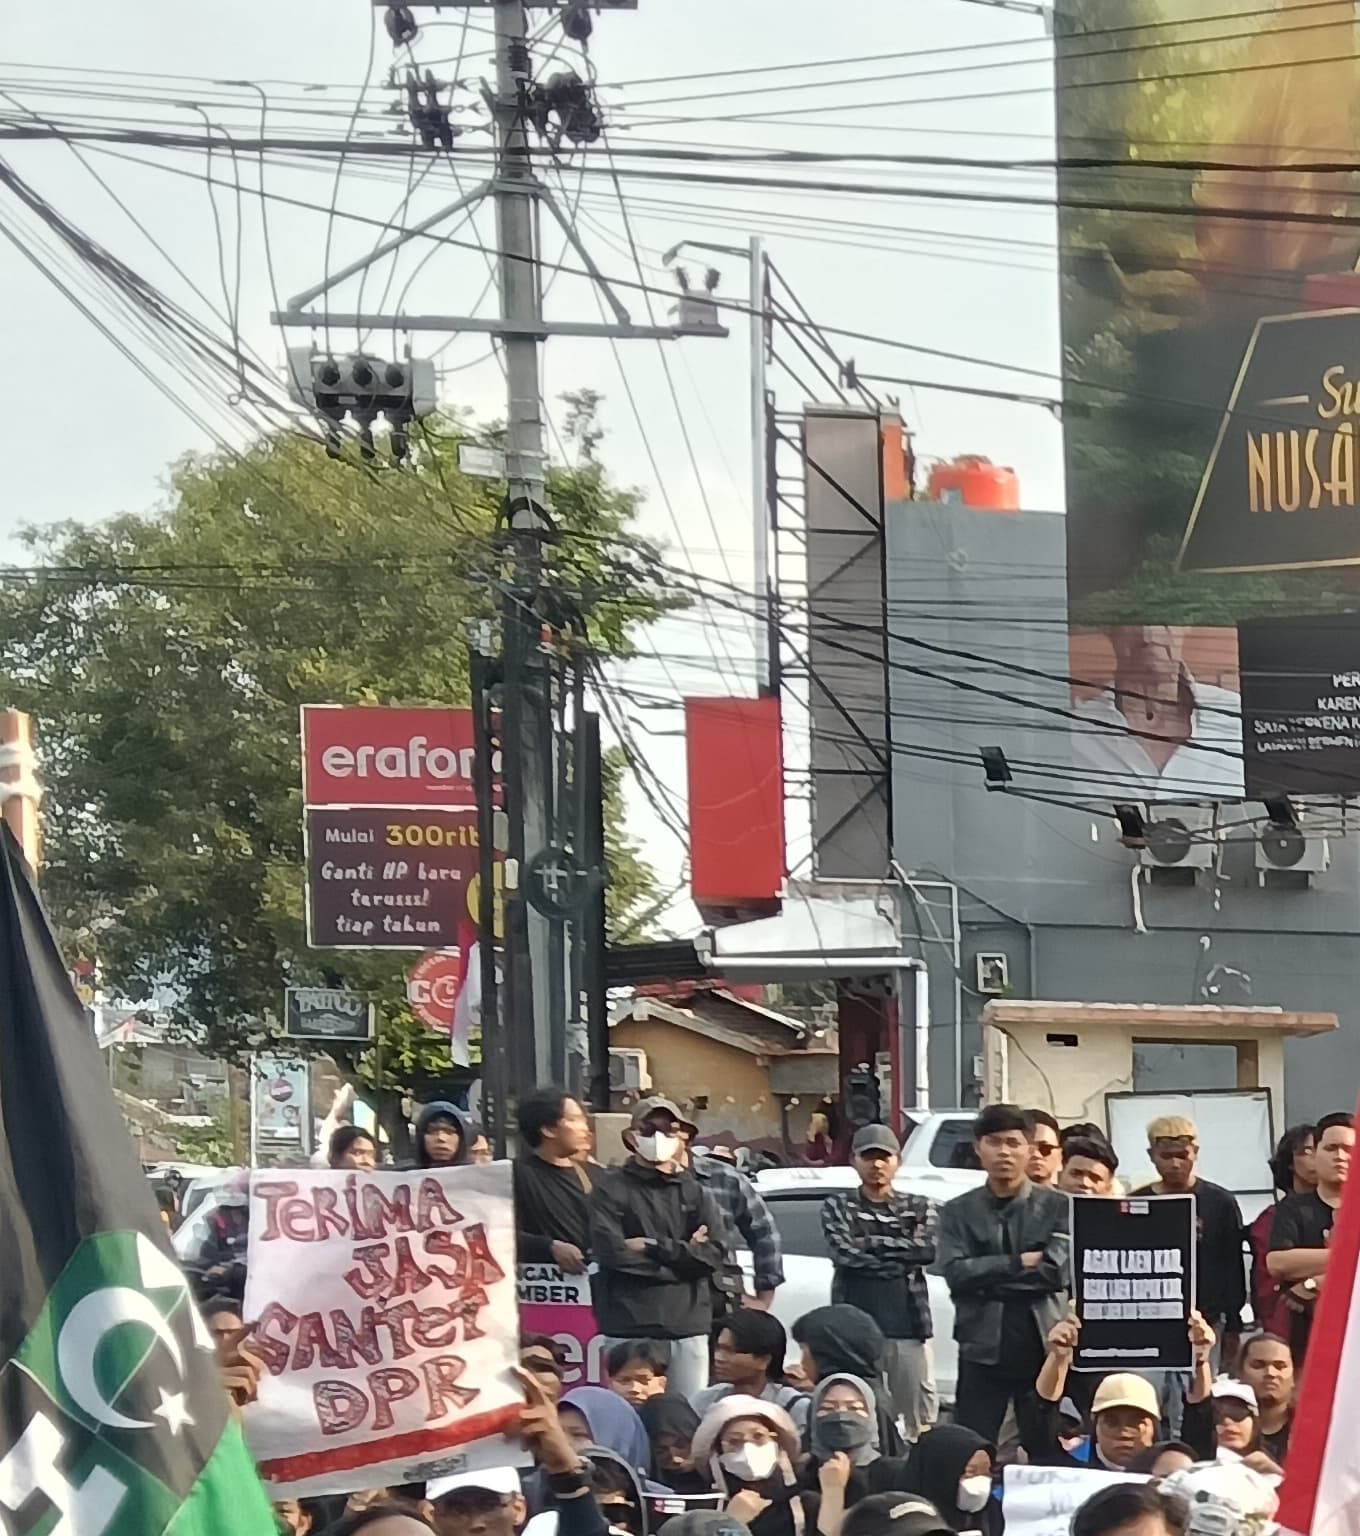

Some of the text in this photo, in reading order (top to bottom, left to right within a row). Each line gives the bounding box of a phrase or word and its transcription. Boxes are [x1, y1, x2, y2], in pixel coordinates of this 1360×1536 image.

[325, 828, 375, 843] Mulai
[321, 861, 374, 880] Ganti
[418, 862, 461, 880] baru
[336, 915, 441, 936] tiap tahun
[343, 1223, 506, 1300] JASA
[312, 1354, 481, 1436] DPR
